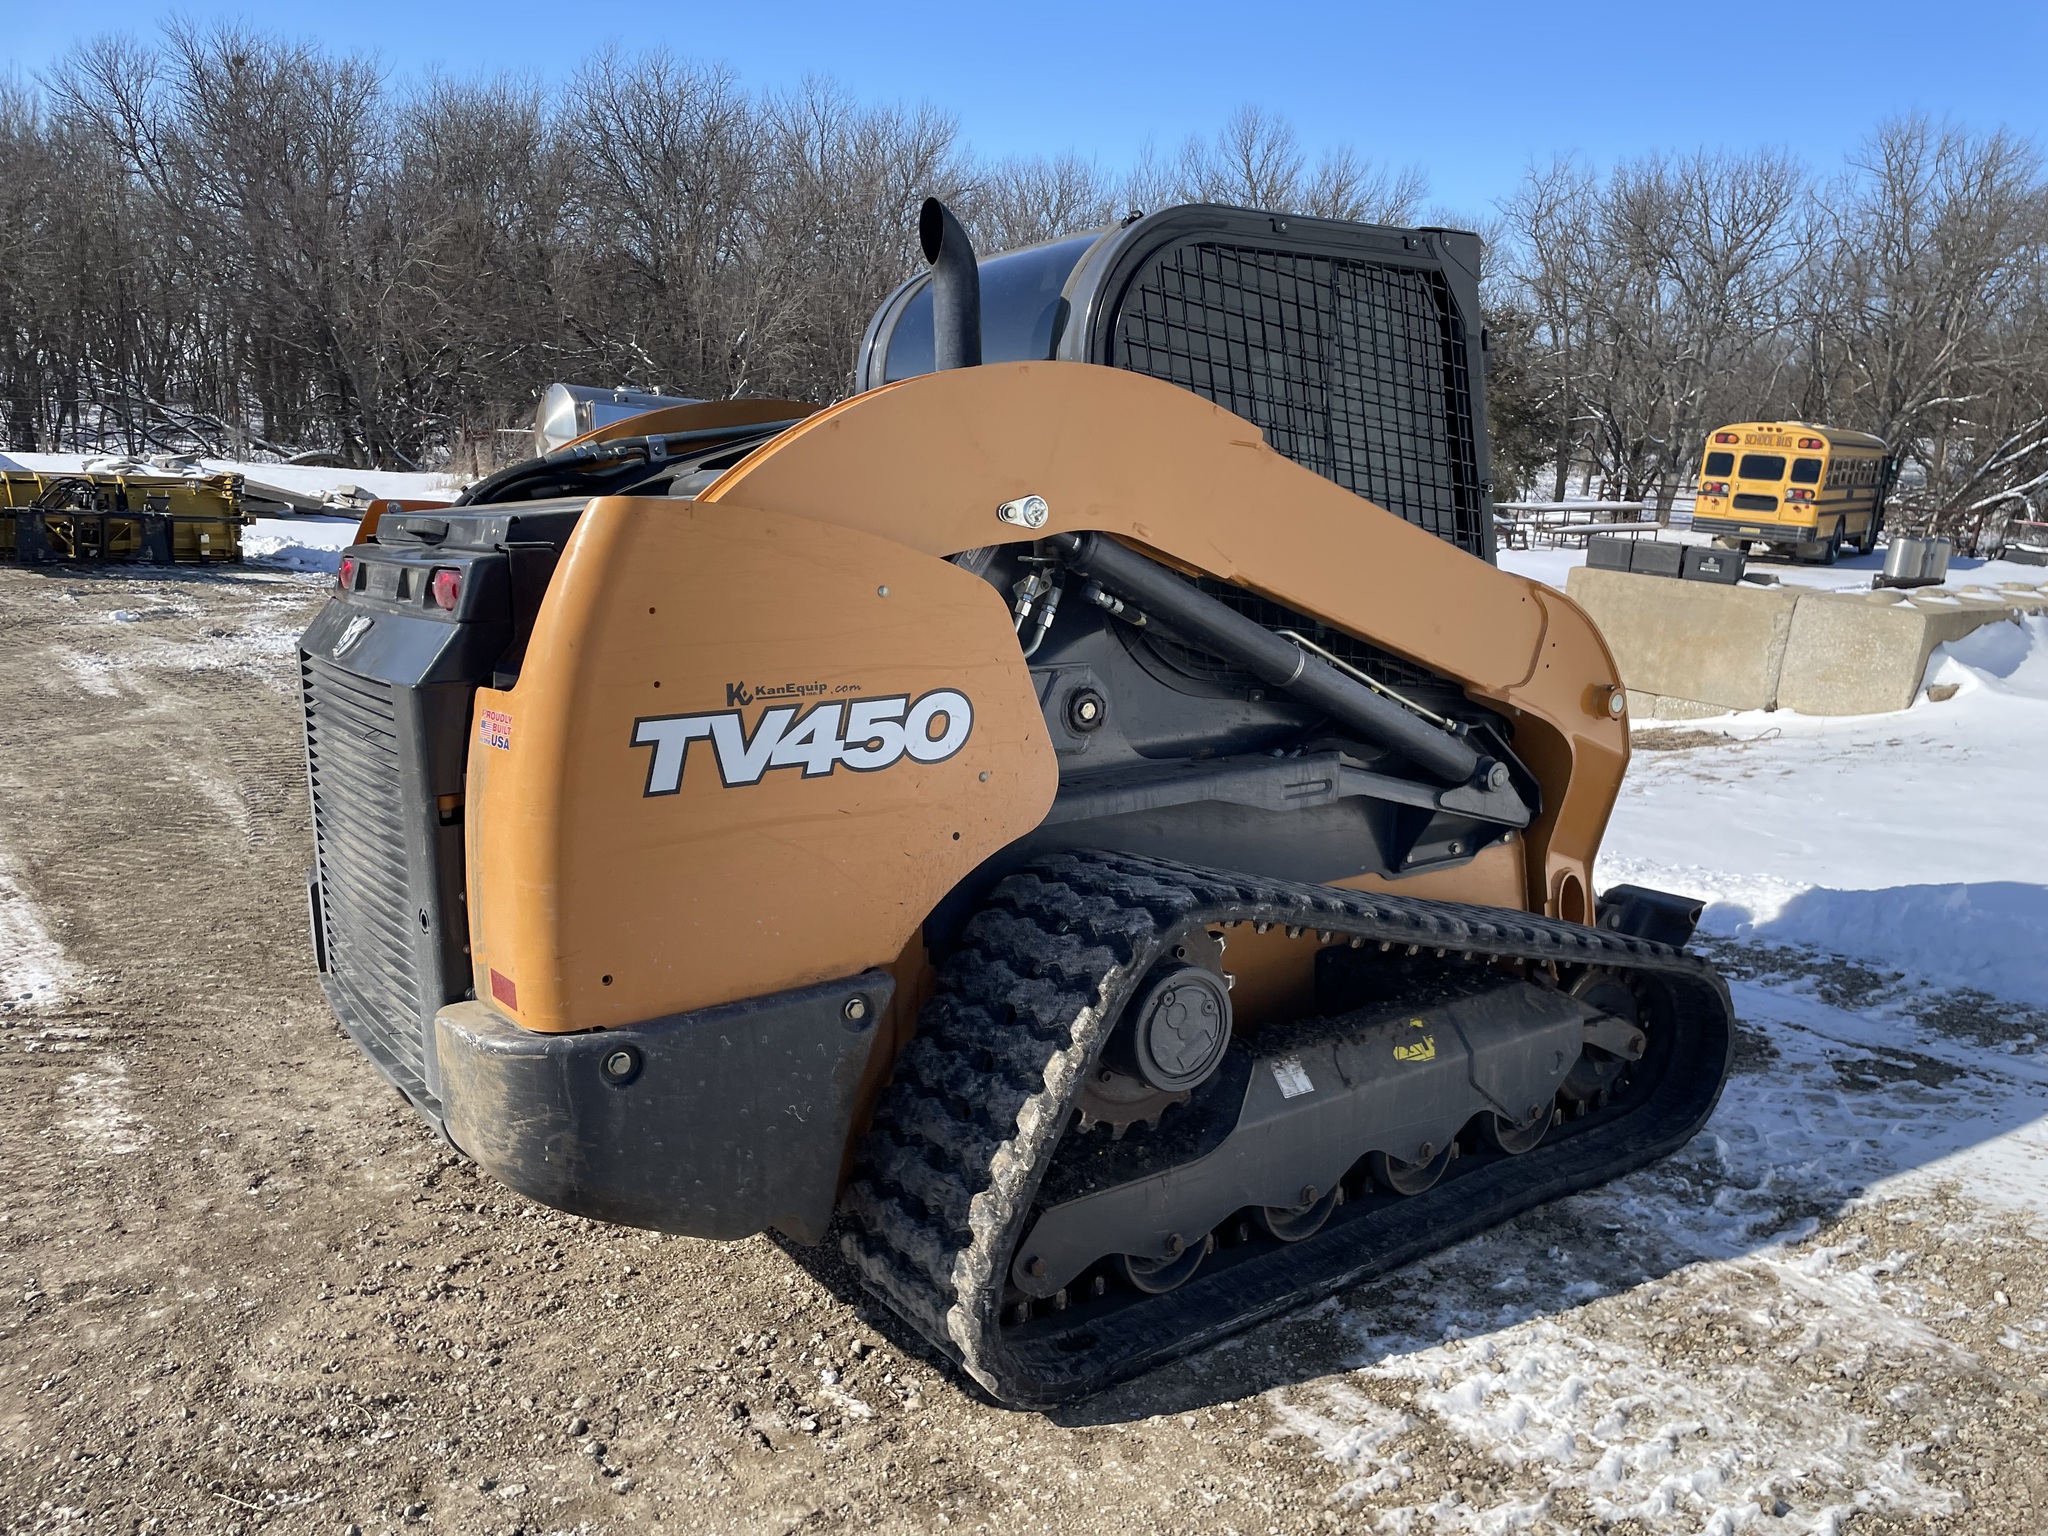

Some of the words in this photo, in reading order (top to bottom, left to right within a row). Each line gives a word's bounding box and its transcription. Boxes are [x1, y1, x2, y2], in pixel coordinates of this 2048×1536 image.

[1745, 433, 1773, 447] SCHOOL
[1776, 436, 1793, 448] BUS
[482, 709, 513, 725] PROUDLY
[492, 723, 512, 736] BUILT
[491, 734, 510, 751] USA
[629, 687, 975, 798] TV450
